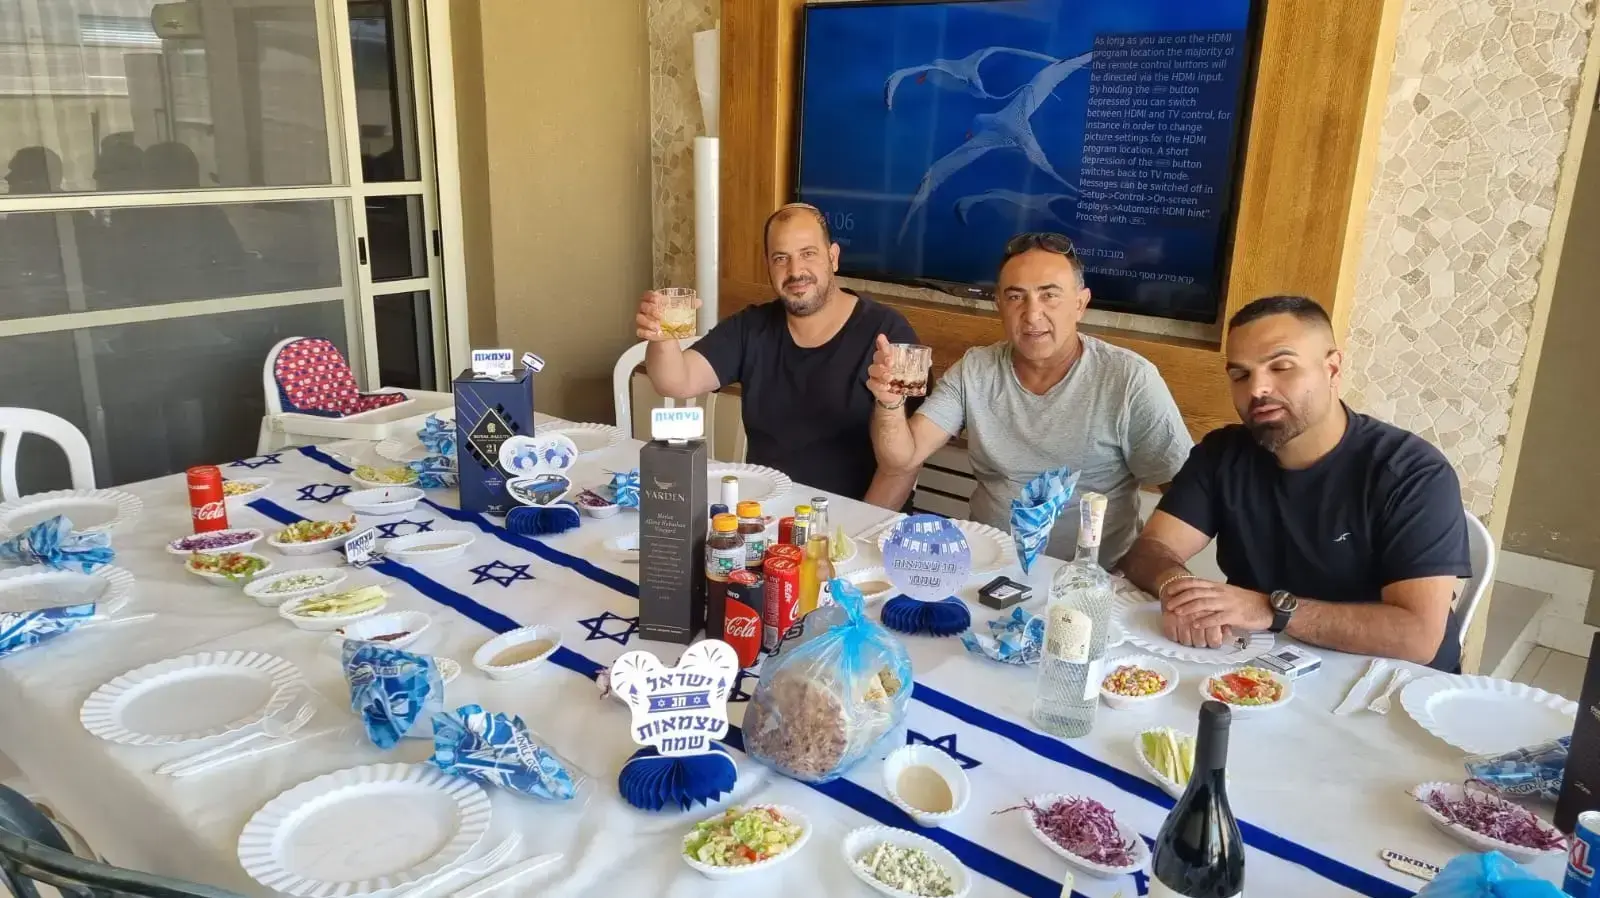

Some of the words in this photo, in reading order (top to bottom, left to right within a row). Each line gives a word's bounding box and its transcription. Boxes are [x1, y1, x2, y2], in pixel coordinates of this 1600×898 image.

[1107, 36, 1124, 46] long
[1139, 37, 1155, 46] you
[1158, 36, 1172, 44] are
[1189, 34, 1204, 43] the
[1207, 33, 1231, 43] HDMI
[1093, 50, 1127, 59] program
[1130, 48, 1164, 57] location
[1167, 48, 1182, 56] the
[1185, 47, 1222, 57] majority
[1093, 61, 1105, 69] the
[1140, 60, 1171, 69] control
[1174, 60, 1208, 69] buttons
[1211, 59, 1226, 69] will
[1103, 72, 1136, 81] directed
[1154, 72, 1169, 81] the
[1171, 72, 1195, 81] HDMI
[1102, 85, 1132, 95] holding
[1135, 85, 1149, 94] the
[1169, 85, 1199, 94] button
[1088, 97, 1130, 106] depressed
[1132, 99, 1148, 107] you
[1168, 97, 1196, 106] switch
[1087, 108, 1121, 117] between
[1124, 109, 1146, 118] HDMI
[1149, 110, 1165, 118] and
[1218, 110, 1231, 120] for
[1085, 120, 1120, 129] instance
[1132, 121, 1155, 130] order
[1170, 122, 1202, 133] change
[1084, 132, 1113, 142] picture
[1115, 133, 1149, 144] settings
[1165, 134, 1180, 143] the
[1182, 135, 1207, 144] HDMI
[1083, 145, 1116, 154] program
[1165, 147, 1188, 156] short
[1081, 157, 1125, 166] depression
[1138, 157, 1152, 167] the
[1172, 159, 1202, 169] button
[1080, 168, 1115, 176] switches
[1117, 168, 1137, 177] back
[1079, 179, 1118, 189] Messages
[1120, 181, 1134, 189] can
[1150, 182, 1188, 192] switched
[1190, 184, 1203, 193] off
[1076, 211, 1107, 222] Proceed
[1109, 215, 1127, 223] with
[1162, 206, 1185, 216] HDMI
[474, 352, 511, 361] עצמאות
[486, 443, 497, 453] 21
[645, 490, 685, 502] YARDEN
[646, 673, 713, 692] ישראל
[671, 696, 687, 707] חג
[637, 715, 725, 741] עצמאות
[661, 735, 705, 752] שמח
